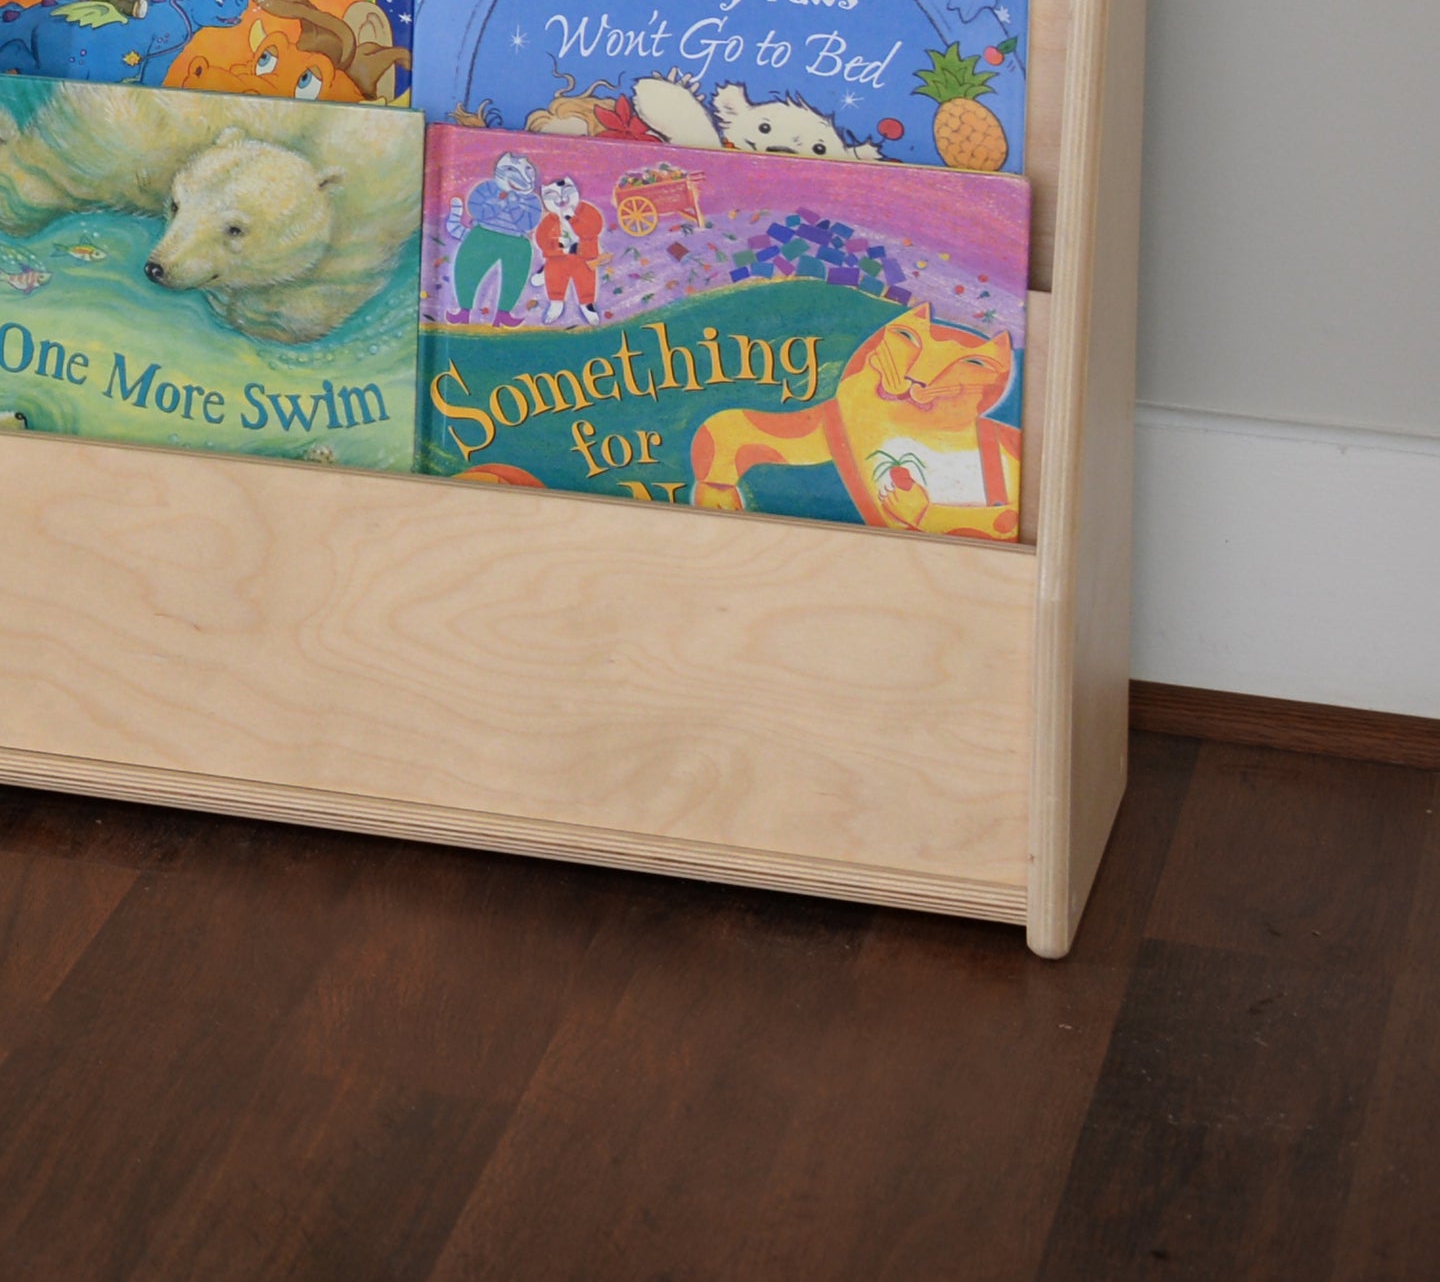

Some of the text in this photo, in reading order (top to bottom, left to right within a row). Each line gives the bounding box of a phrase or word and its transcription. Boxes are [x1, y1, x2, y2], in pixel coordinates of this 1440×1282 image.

[544, 9, 904, 90] Won't Go to Bed
[103, 351, 226, 425] More
[240, 378, 391, 433] Swim
[429, 320, 826, 461] Something
[570, 419, 663, 479] for
